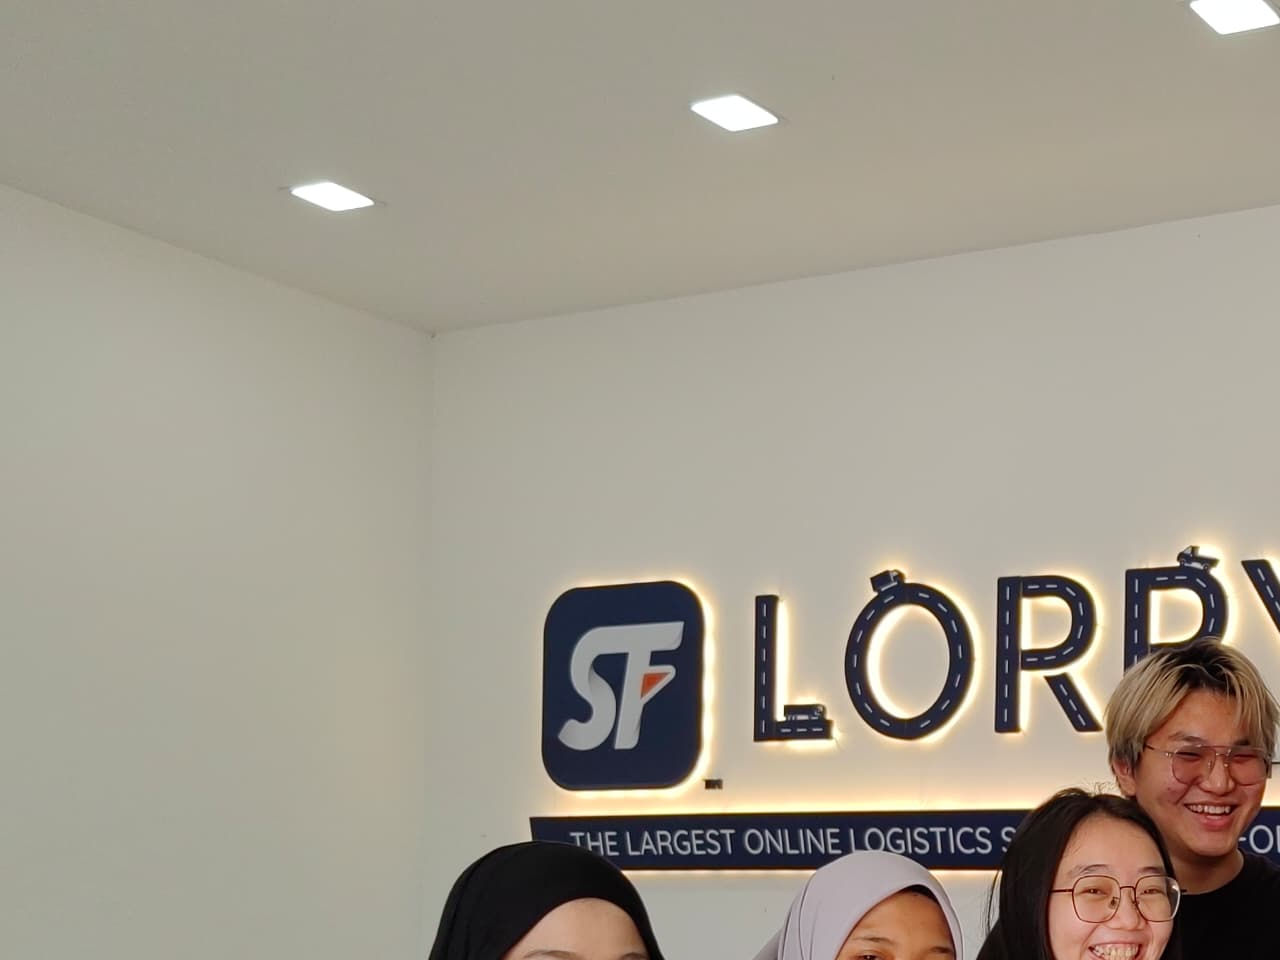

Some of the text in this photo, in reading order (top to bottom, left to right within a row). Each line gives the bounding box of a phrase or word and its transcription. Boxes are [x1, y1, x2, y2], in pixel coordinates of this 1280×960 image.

[569, 831, 620, 856] THE
[625, 829, 736, 856] LARGEST
[744, 827, 842, 855] ONLINE
[849, 826, 993, 854] LOGISTICS
